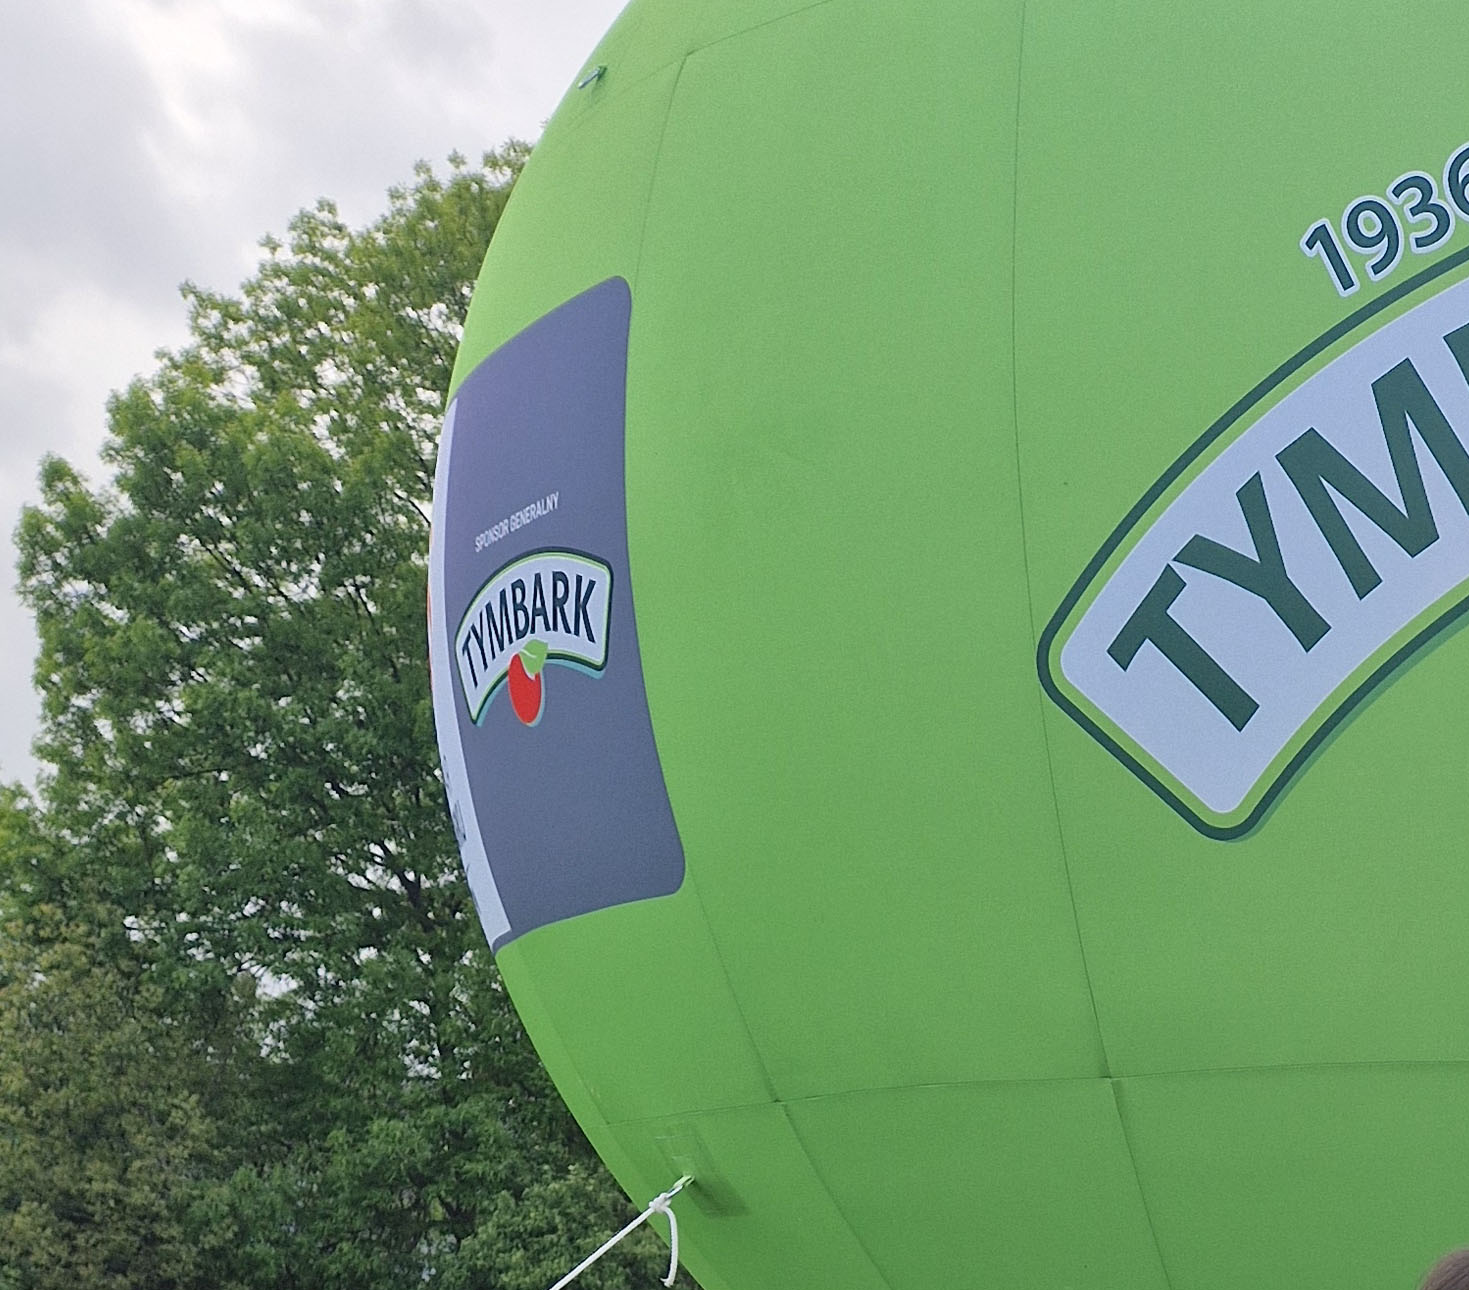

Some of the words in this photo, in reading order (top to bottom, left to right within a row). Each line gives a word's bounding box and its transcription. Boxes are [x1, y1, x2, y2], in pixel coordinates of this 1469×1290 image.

[474, 518, 510, 552] SPONSOR
[509, 491, 560, 531] GENERALNY
[462, 570, 597, 688] TYMBARK
